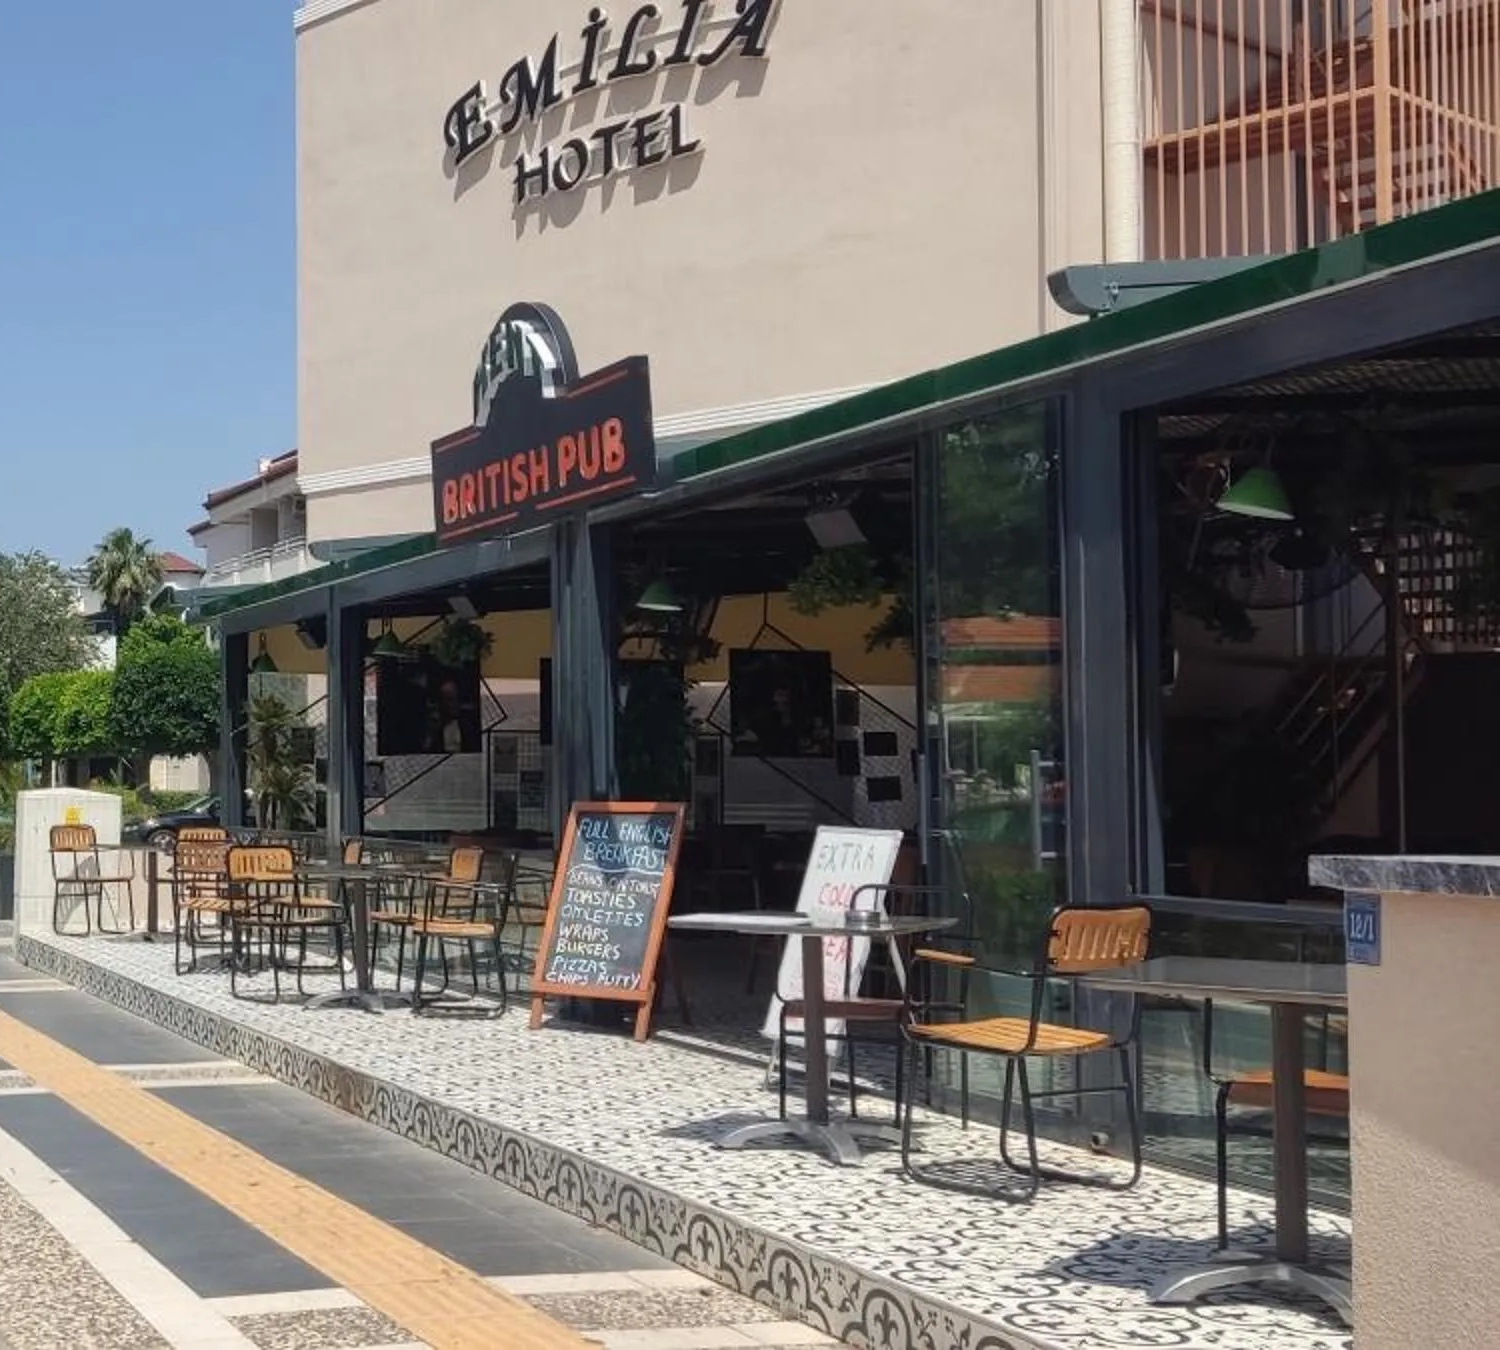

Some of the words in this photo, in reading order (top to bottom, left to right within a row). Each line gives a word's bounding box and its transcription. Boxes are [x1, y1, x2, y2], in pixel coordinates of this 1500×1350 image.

[513, 103, 702, 202] HOTEL
[443, 444, 549, 524] BRITISH
[557, 417, 625, 488] PUB
[577, 817, 610, 840] FULL
[618, 821, 674, 846] ENGLISH
[583, 842, 668, 869] BREAKFAST
[818, 842, 876, 873] EXTRA
[565, 889, 638, 909] TOASTIES
[561, 904, 645, 927] OMLETTES
[559, 922, 610, 942] WRAPS
[555, 938, 621, 960] BURGERS
